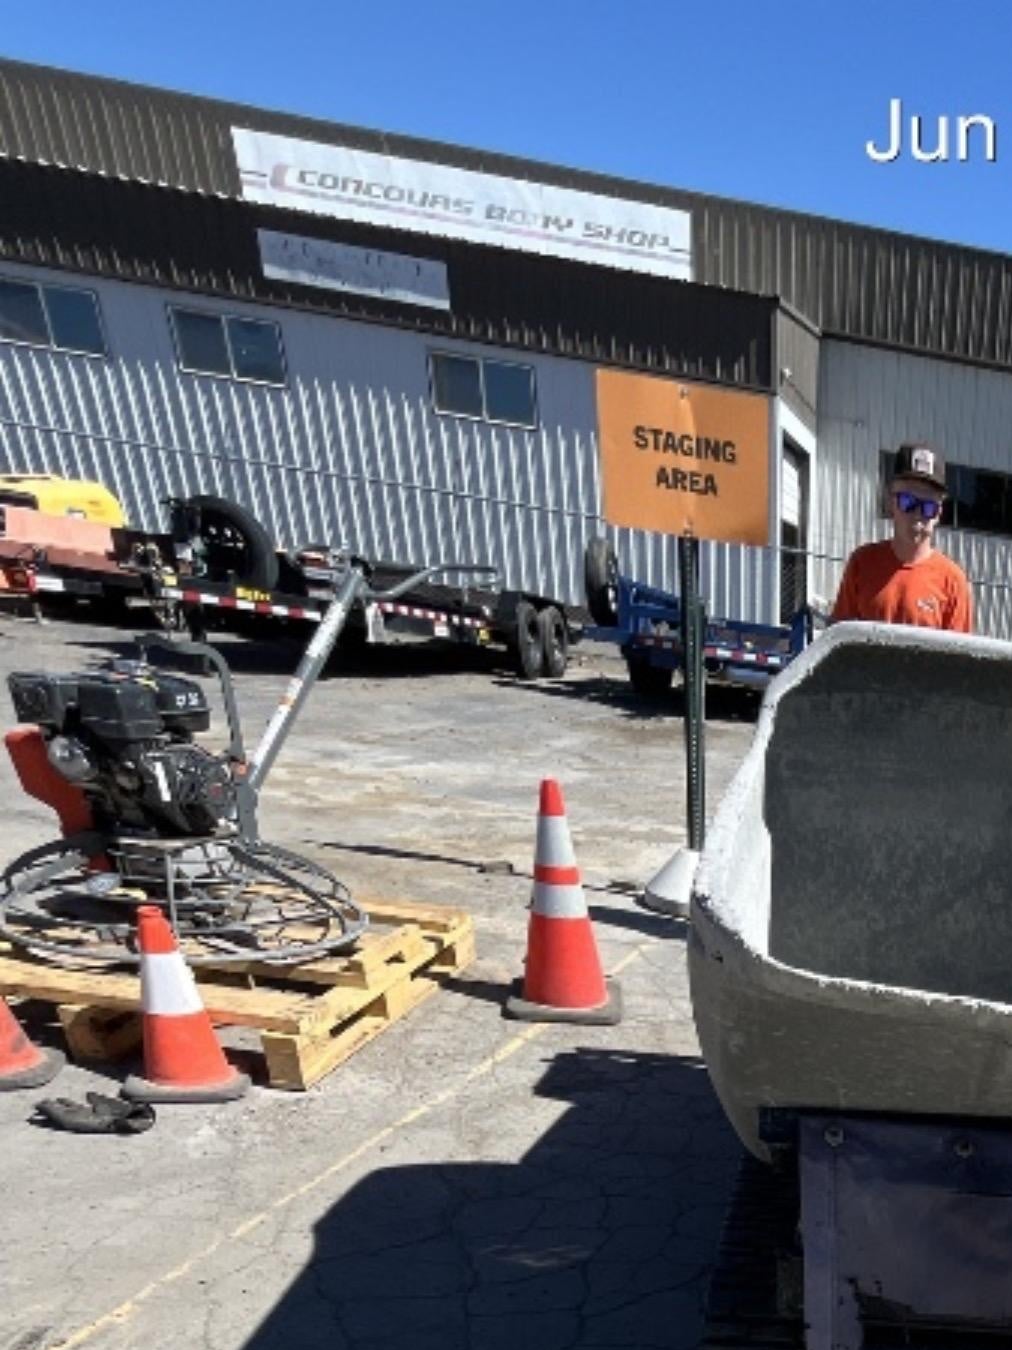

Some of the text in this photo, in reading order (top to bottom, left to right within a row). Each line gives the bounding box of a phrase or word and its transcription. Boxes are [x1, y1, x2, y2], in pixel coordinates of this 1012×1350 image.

[582, 221, 671, 250] SHOP
[633, 424, 737, 464] STAGING
[656, 465, 719, 497] AREA
